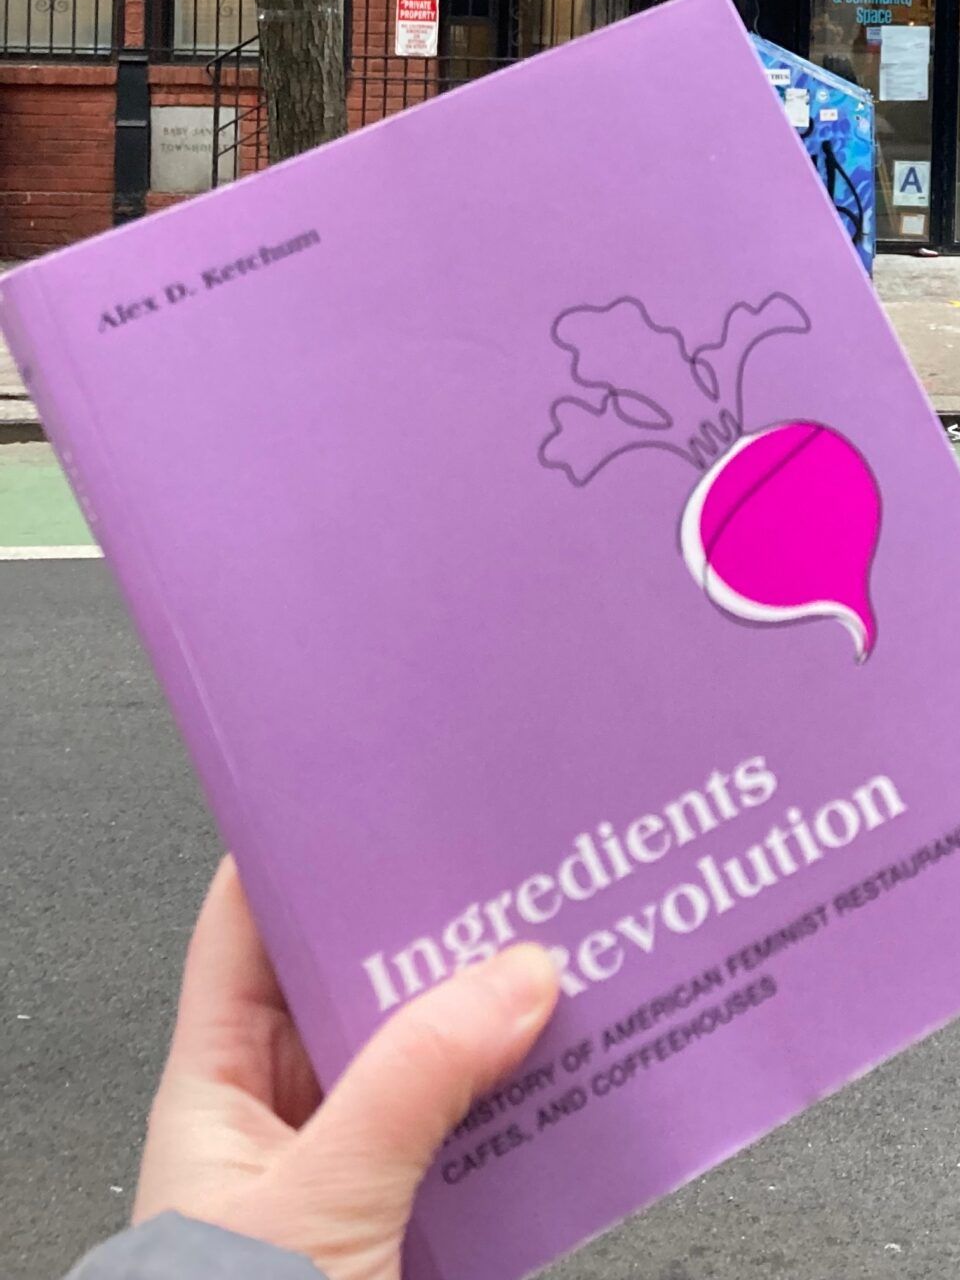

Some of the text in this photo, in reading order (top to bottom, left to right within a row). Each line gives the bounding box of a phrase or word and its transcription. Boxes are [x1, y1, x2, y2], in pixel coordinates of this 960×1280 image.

[400, 9, 436, 20] PROPERTY
[403, 0, 432, 10] PRIVATE
[856, 7, 892, 25] Space
[900, 167, 923, 193] A
[98, 228, 321, 334] Alex D. Ketchum
[362, 754, 778, 1013] Ingredients
[562, 1039, 594, 1073] OF
[602, 965, 724, 1052] AMERICAN
[725, 904, 829, 978] FEMINIST
[537, 1085, 589, 1131] AND
[591, 974, 778, 1097] COFFEEHOUSES
